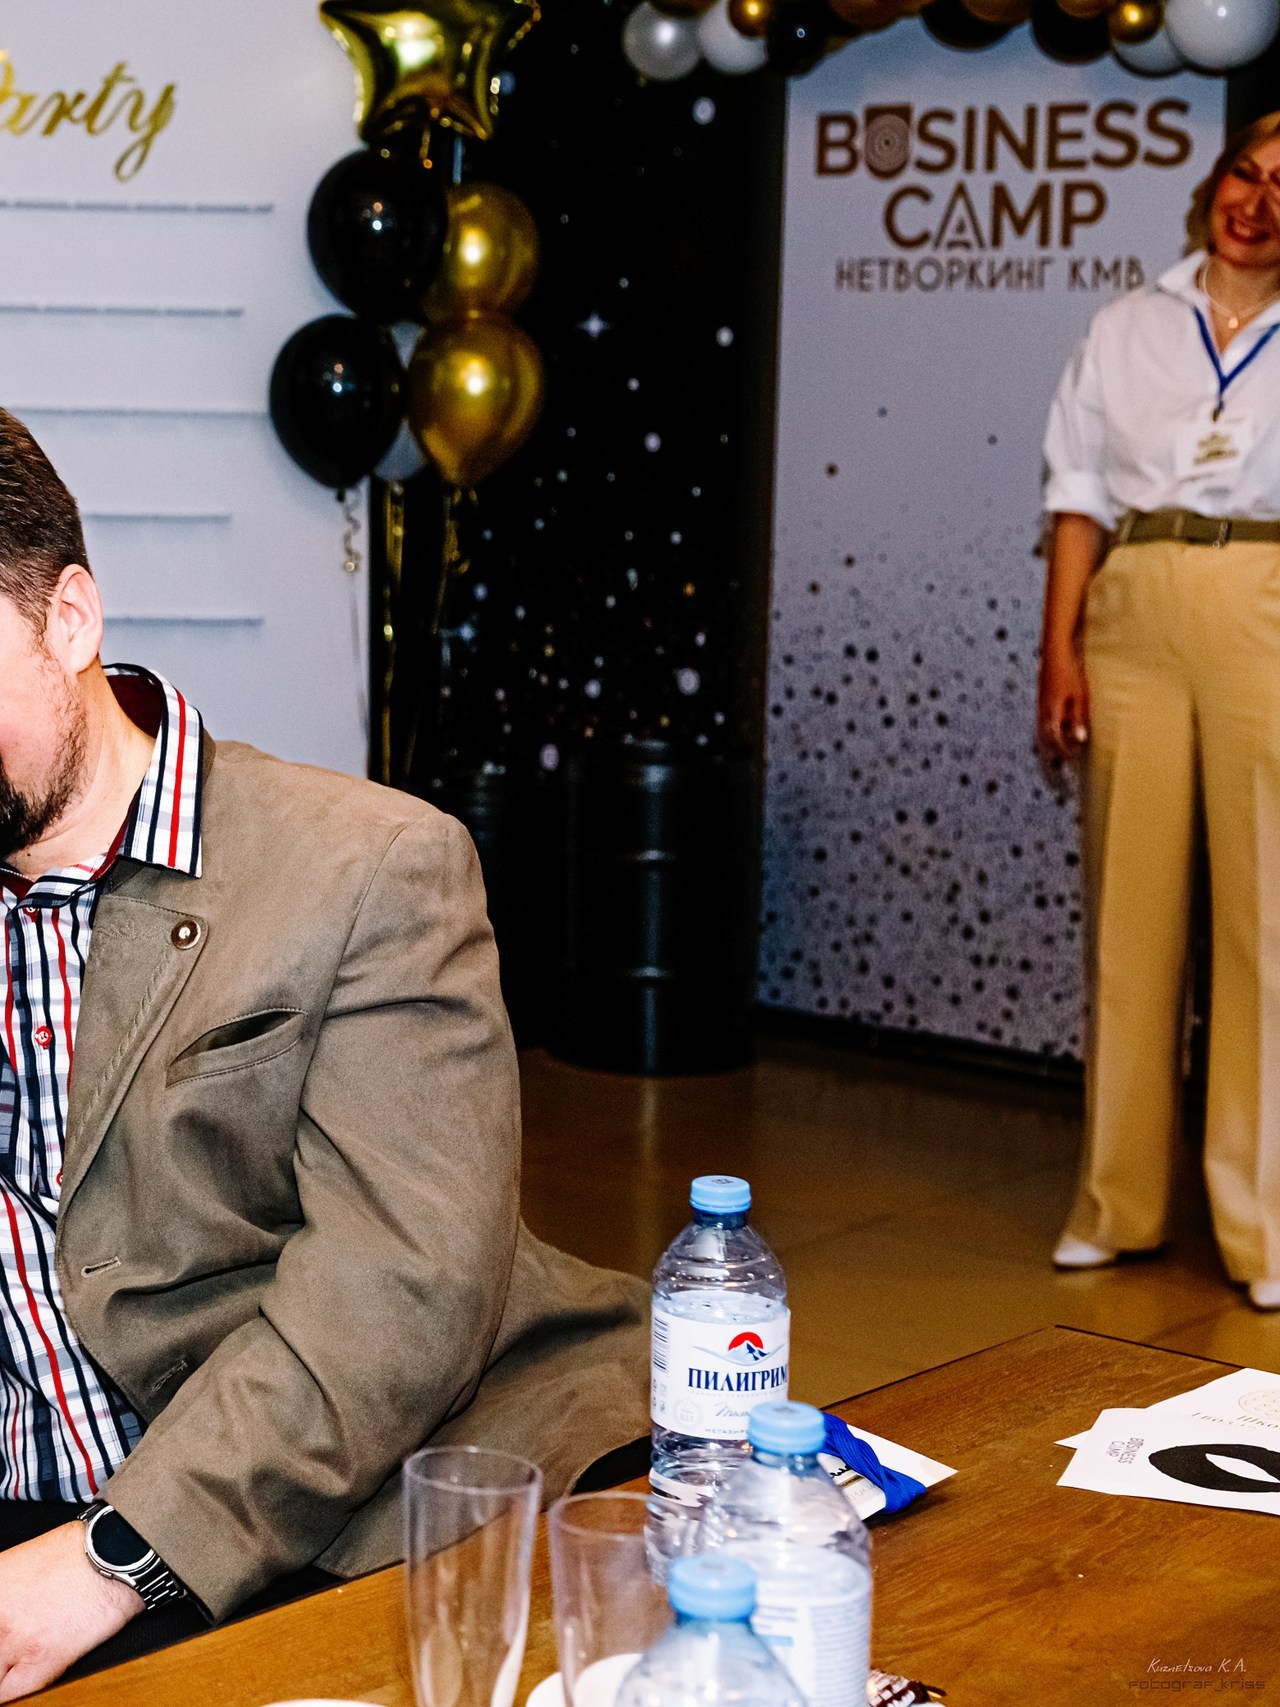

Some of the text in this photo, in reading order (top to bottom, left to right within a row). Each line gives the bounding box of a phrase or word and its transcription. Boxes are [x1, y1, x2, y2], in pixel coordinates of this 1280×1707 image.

[883, 180, 1108, 250] CAMP
[835, 256, 1144, 292] НЕТВОРКИНГ КМВ
